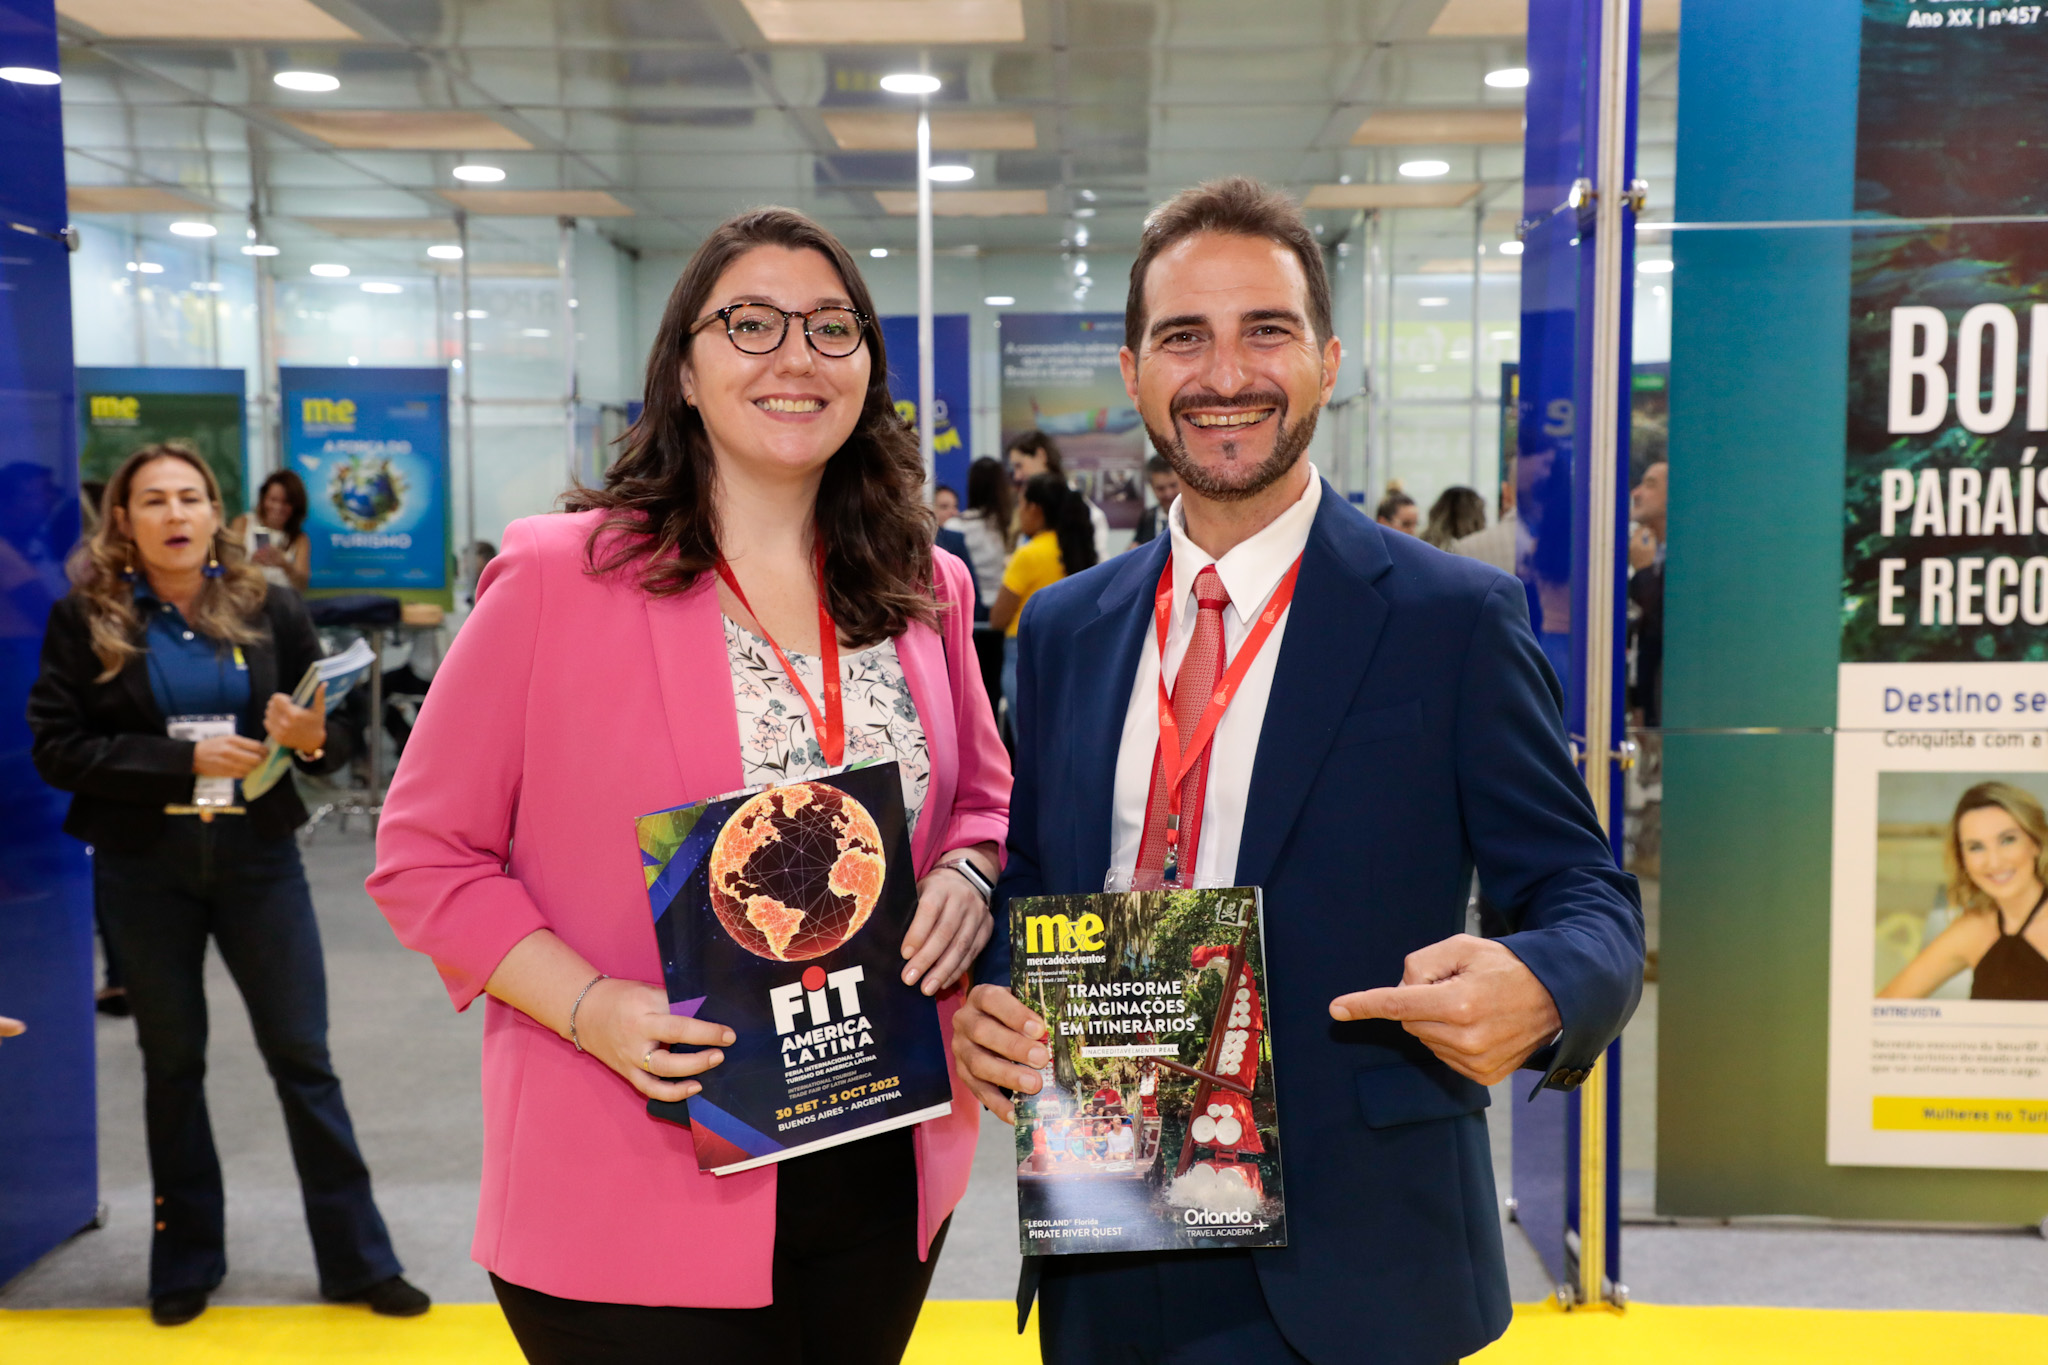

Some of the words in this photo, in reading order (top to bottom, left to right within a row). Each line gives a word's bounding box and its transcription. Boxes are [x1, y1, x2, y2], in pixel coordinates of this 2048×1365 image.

[1907, 9, 1944, 28] Ano
[1946, 8, 1974, 27] XX
[1878, 557, 1906, 627] E
[1884, 687, 2001, 713] Destino
[1883, 730, 1976, 751] Conquista
[1984, 733, 2024, 748] com
[2032, 734, 2042, 748] a
[1026, 954, 1106, 966] mercado&eventos
[1067, 980, 1182, 998] TRANSFORME
[1066, 997, 1186, 1018] IMAGINAÇÕES
[1872, 1006, 1941, 1018] ENTREVISTA
[780, 1015, 873, 1053] AMERICA
[1060, 1021, 1084, 1036] EM
[1088, 1016, 1196, 1035] ITINERÁRIOS
[782, 1031, 875, 1069] LATINA
[1085, 1047, 1156, 1055] INACREDITAVELMENTE
[784, 1067, 804, 1078] FERIA
[804, 1053, 855, 1074] INTERNACIONAL
[854, 1050, 865, 1058] DE
[785, 1072, 815, 1085] TURISMO
[815, 1068, 825, 1077] DE
[825, 1061, 854, 1074] AMERICA
[854, 1054, 877, 1066] LATINA
[788, 1077, 831, 1094] INTERNATIONAL
[832, 1070, 857, 1081] TOURISM
[788, 1091, 808, 1100] TRADE
[808, 1087, 822, 1095] FAIR
[830, 1079, 846, 1089] LATIN
[846, 1071, 873, 1084] AMERICA
[775, 1107, 793, 1120] 30
[794, 1098, 820, 1114] SET
[829, 1093, 839, 1105] 3
[840, 1085, 867, 1101] OCT
[869, 1075, 900, 1093] 2023
[778, 1114, 817, 1132] BUENOS
[817, 1106, 844, 1121] AIRES
[850, 1090, 902, 1111] ARGENTINA
[1923, 1108, 1989, 1121] Mulheres
[1996, 1111, 2013, 1122] no
[1074, 1218, 1099, 1226] Florida
[1184, 1207, 1252, 1225] Orlando
[1029, 1229, 1061, 1239] PIRATE
[1062, 1228, 1090, 1238] RIVER
[1091, 1227, 1123, 1238] QUEST
[1186, 1229, 1215, 1237] TRAVEL
